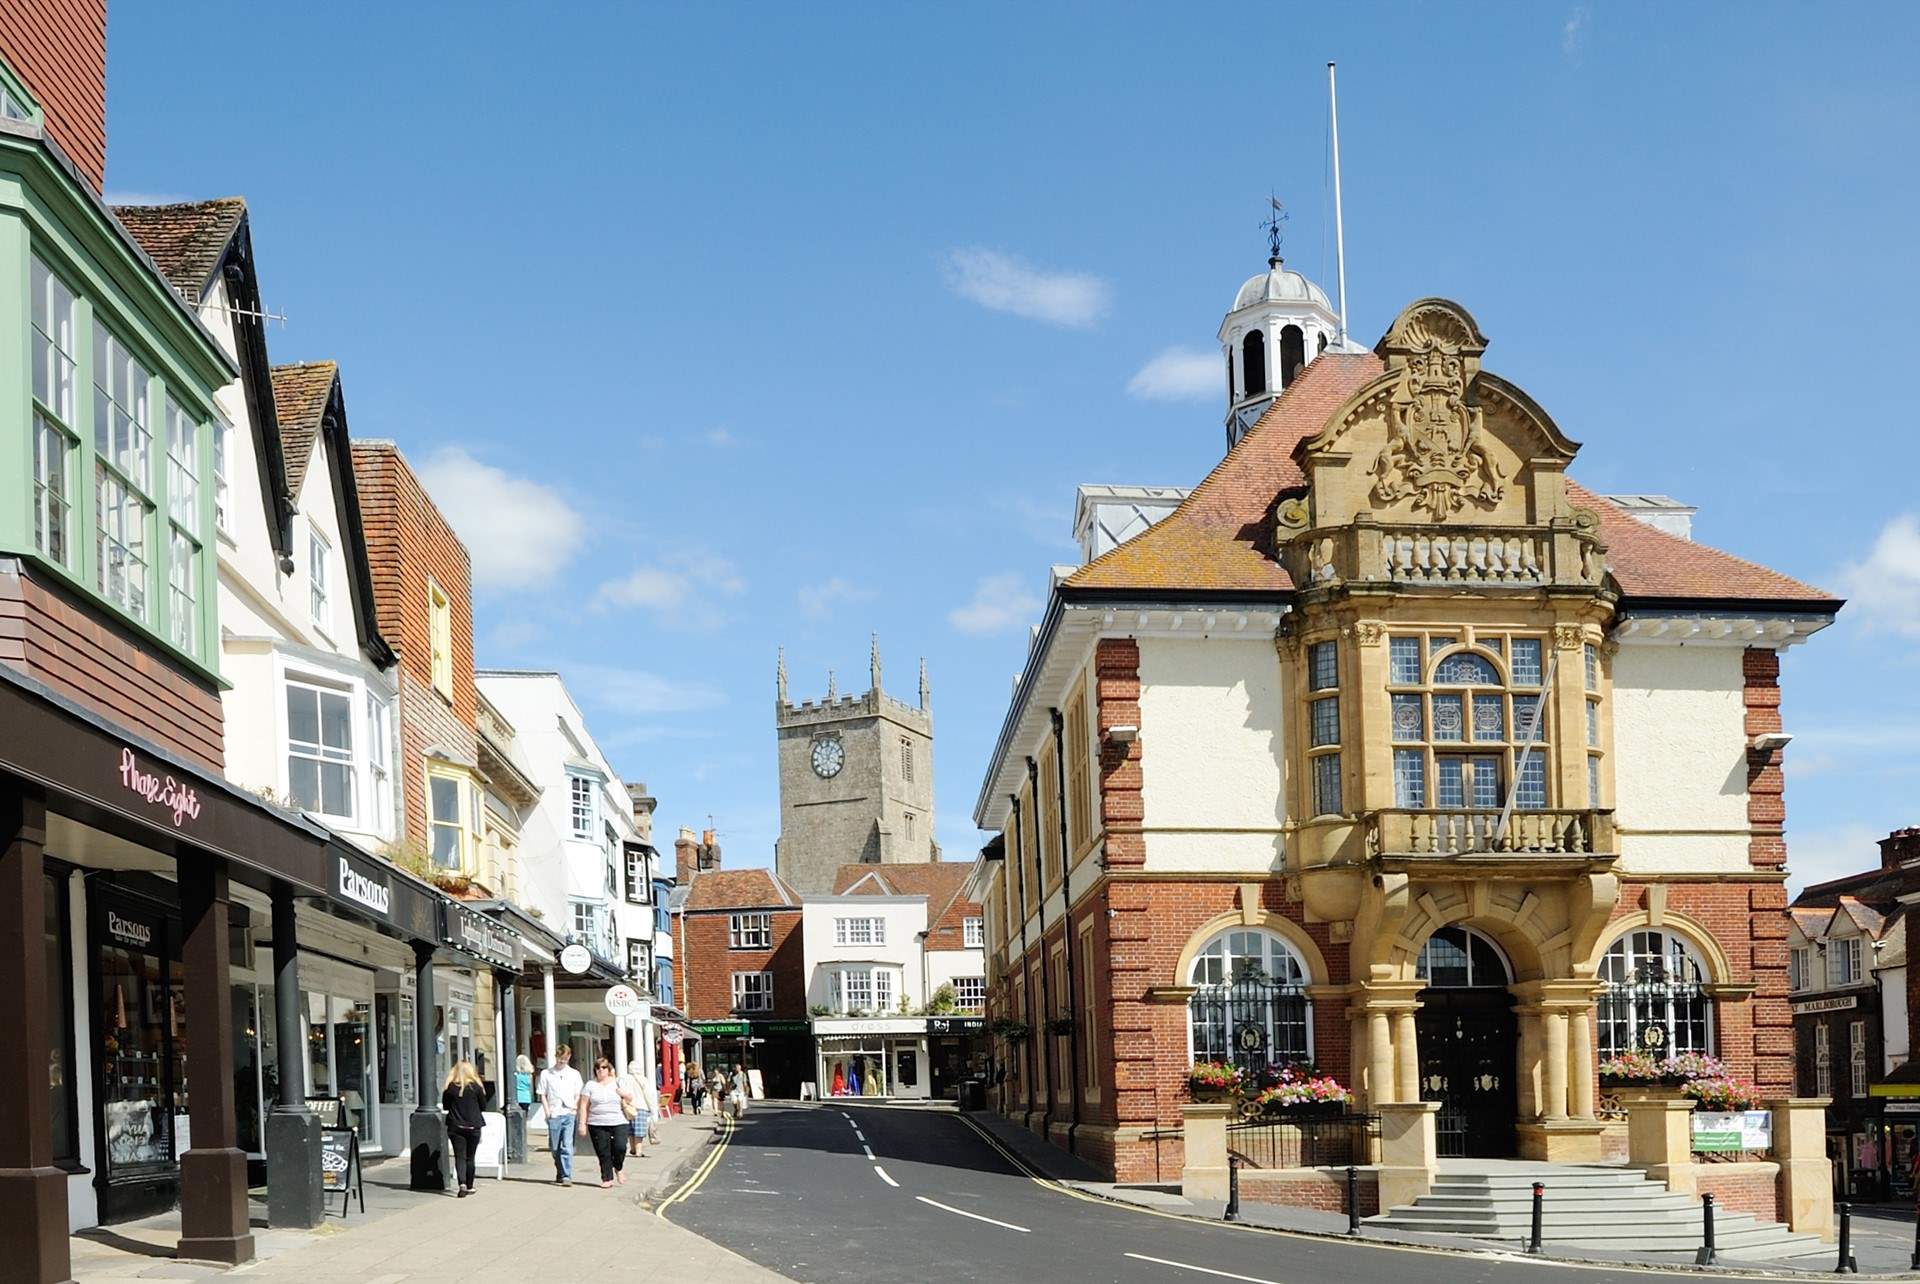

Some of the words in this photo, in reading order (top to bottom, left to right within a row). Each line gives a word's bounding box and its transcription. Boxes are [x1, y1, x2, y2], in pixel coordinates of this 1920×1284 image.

[119, 747, 163, 803] Phase
[163, 775, 200, 827] Eight
[338, 856, 389, 914] Parsons
[108, 911, 151, 942] Parsons
[608, 999, 633, 1008] HSBC
[716, 1025, 743, 1033] GEORGE
